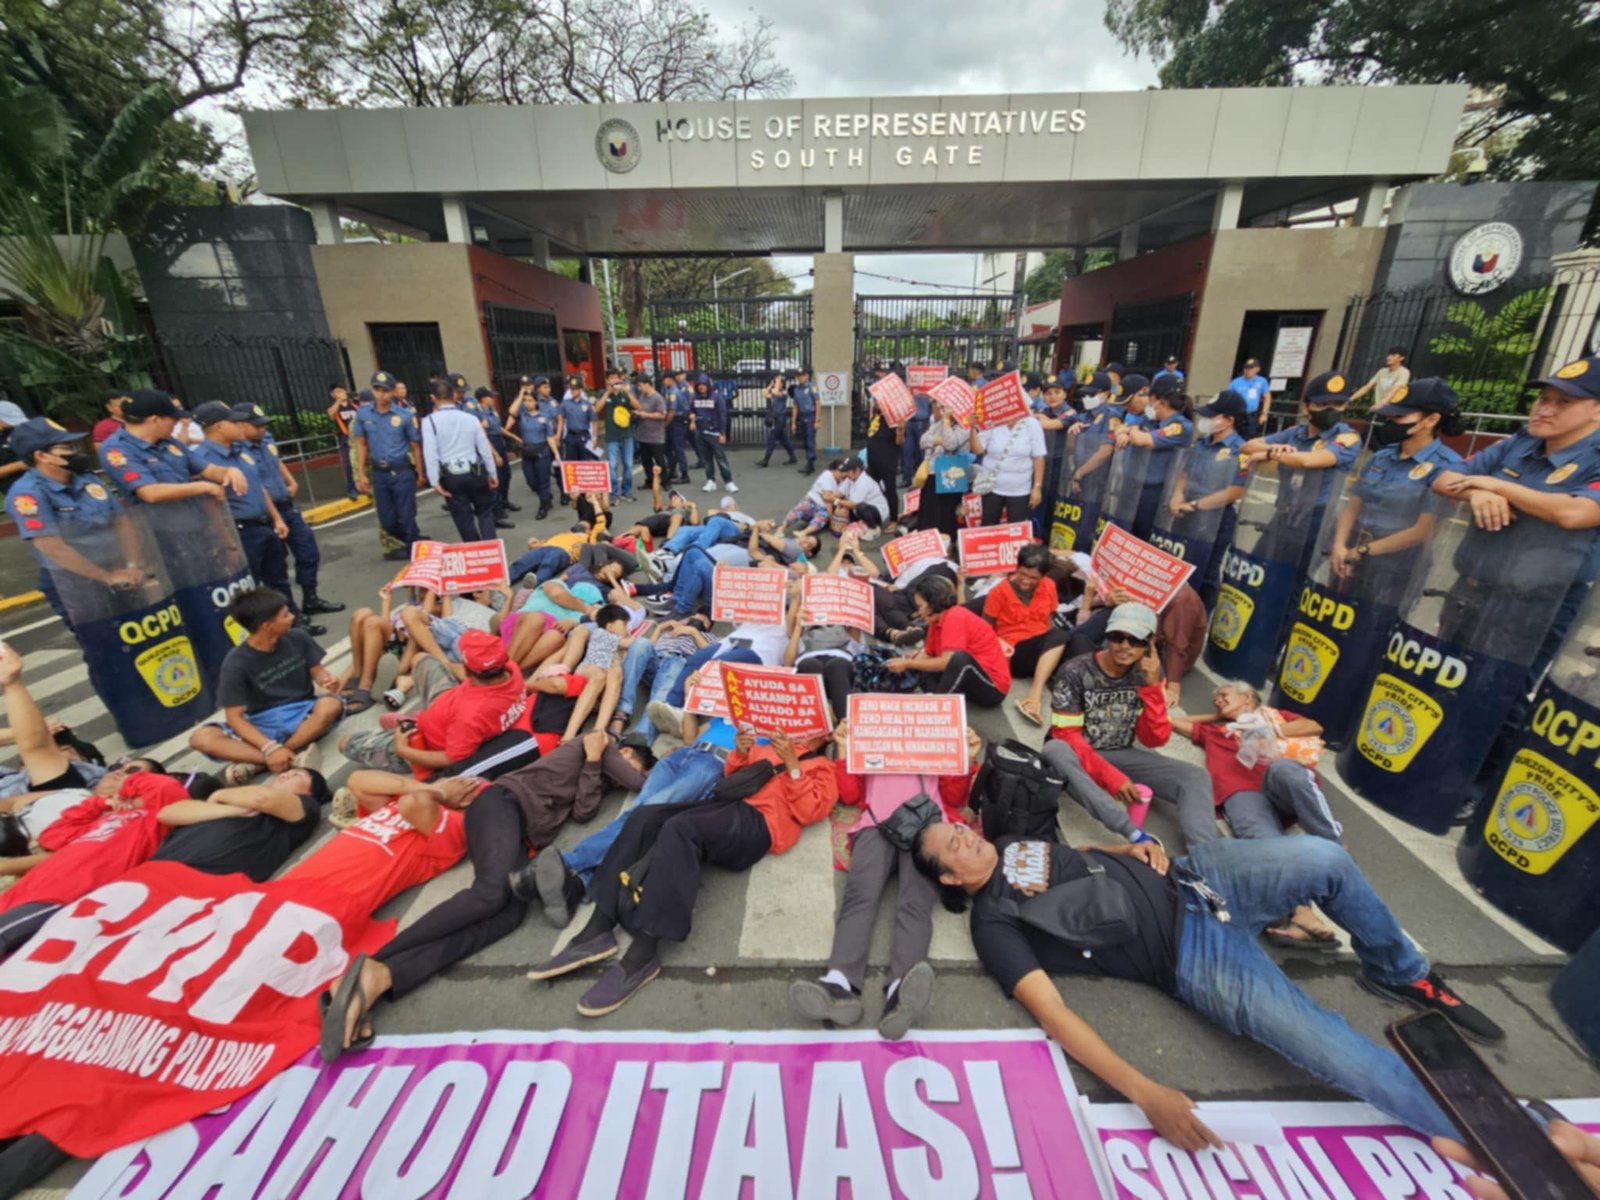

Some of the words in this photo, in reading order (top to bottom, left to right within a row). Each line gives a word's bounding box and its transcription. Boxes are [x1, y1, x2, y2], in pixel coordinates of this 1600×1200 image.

[656, 116, 752, 142] HOUSE
[765, 116, 801, 139] OF
[813, 109, 1087, 138] REPRESENTATIVES
[751, 147, 864, 169] SOUTH
[896, 145, 983, 166] GATE
[1220, 547, 1265, 587] QCPD
[119, 604, 182, 645] QCPD
[1300, 587, 1355, 631] QCPD
[1387, 632, 1468, 689] QCPD
[172, 687, 198, 705] QCPD
[744, 678, 786, 691] AYUDA
[788, 682, 807, 693] SA
[745, 690, 798, 705] KAKAMPI
[799, 695, 816, 706] AT
[1385, 691, 1414, 710] PRIDE
[748, 702, 794, 716] ALYADO
[797, 706, 816, 717] SA
[751, 714, 813, 727] POLITIKA
[1407, 693, 1440, 719] CITY'S
[1532, 698, 1600, 769] QCP
[1360, 743, 1393, 769] QCPD
[1514, 756, 1555, 779] QUEZON
[1555, 777, 1599, 813] CITY'S
[1526, 771, 1565, 799] PRIDE
[1489, 832, 1531, 869] QCPD
[0, 881, 350, 1025] BMP
[161, 1033, 275, 1092] PILIPINO
[577, 1057, 1034, 1200] ITAAS!
